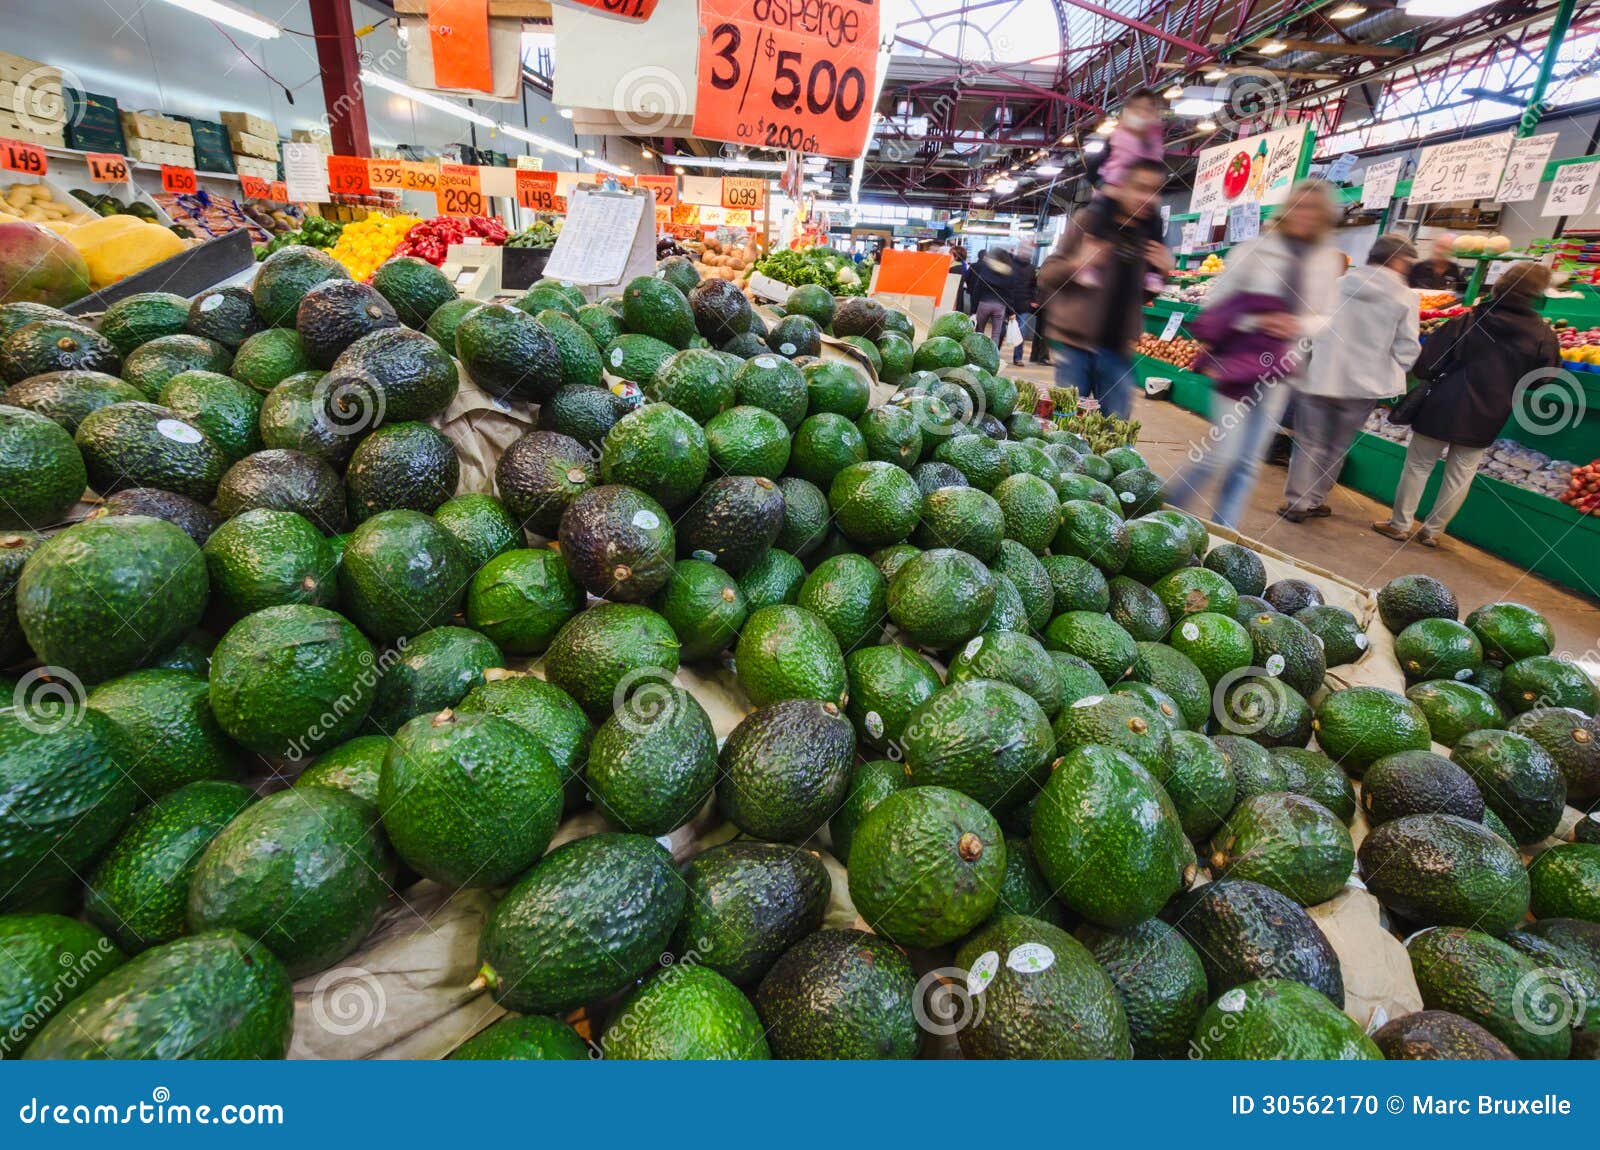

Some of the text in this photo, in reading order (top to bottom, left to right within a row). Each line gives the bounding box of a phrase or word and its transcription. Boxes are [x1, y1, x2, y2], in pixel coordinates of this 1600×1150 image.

[9, 147, 42, 172] 1.49
[92, 161, 126, 180] 1.49
[407, 170, 437, 188] 3.99
[445, 189, 481, 215] 2.99
[729, 188, 757, 206] 0.99
